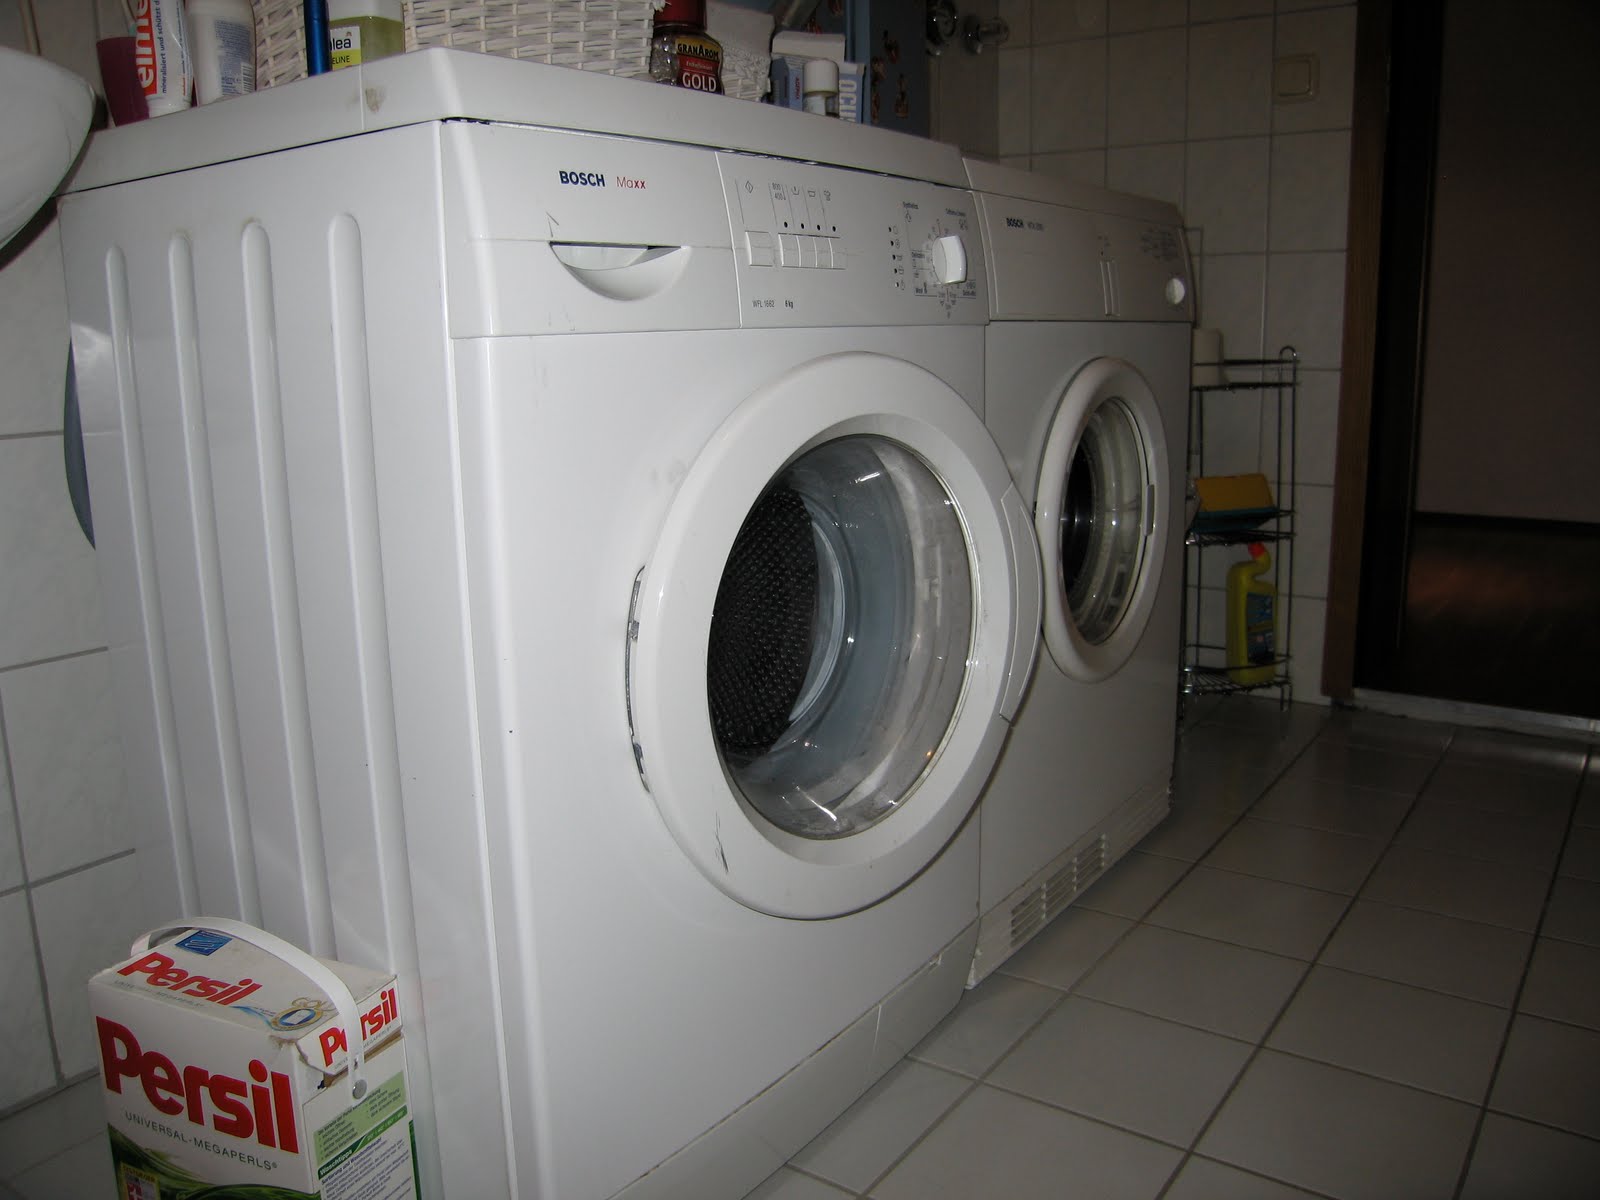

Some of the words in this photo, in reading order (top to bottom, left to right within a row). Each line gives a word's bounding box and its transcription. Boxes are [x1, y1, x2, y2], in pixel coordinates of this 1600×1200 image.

[157, 37, 165, 51] und
[330, 38, 351, 50] lea
[682, 72, 717, 93] GOLD
[559, 170, 606, 188] BOSCH
[616, 176, 646, 189] Maxx
[117, 951, 263, 1006] Persil
[96, 1015, 299, 1155] Persil
